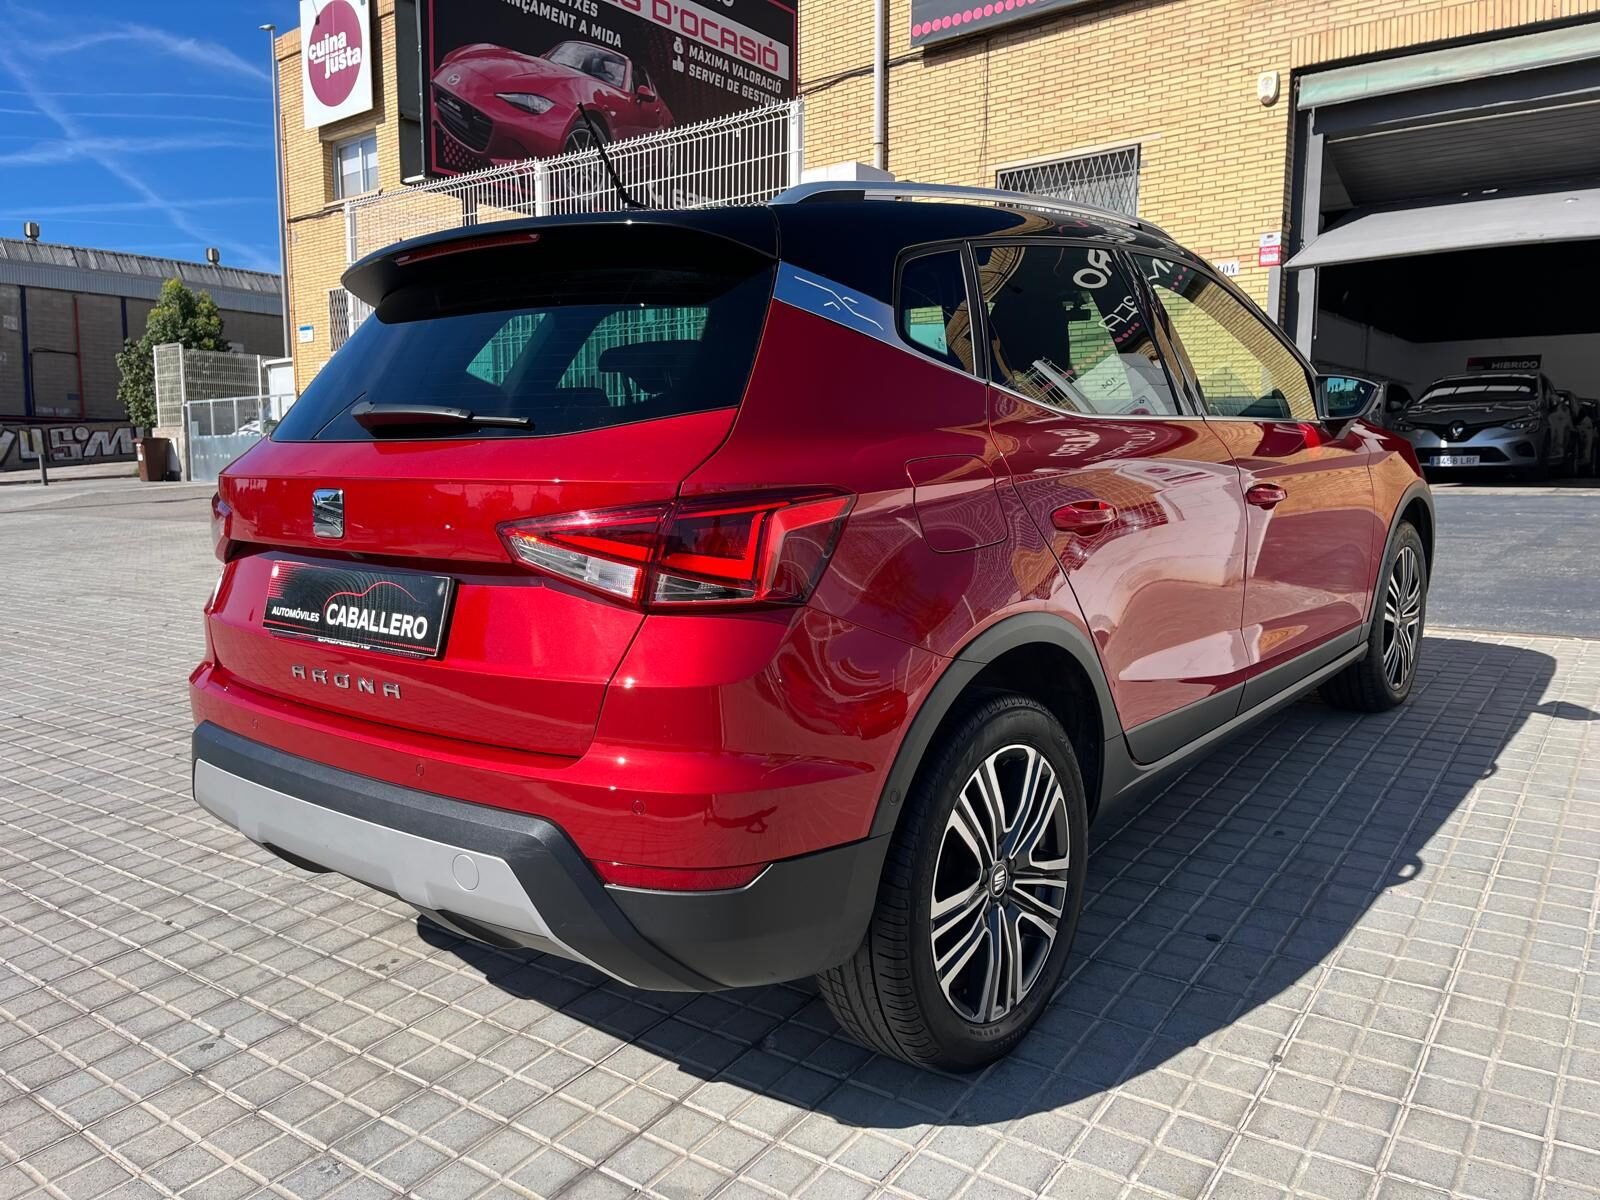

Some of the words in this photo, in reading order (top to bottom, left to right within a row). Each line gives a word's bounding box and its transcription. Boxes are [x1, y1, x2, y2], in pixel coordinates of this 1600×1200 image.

[308, 31, 347, 60] cuina
[578, 19, 588, 35] A
[591, 23, 622, 48] MIDA
[652, 0, 779, 72] D'OCASIÓ
[324, 46, 361, 80] justa
[689, 44, 729, 73] MÀXIMA
[732, 62, 782, 94] VALORACIÓ
[689, 64, 724, 89] SERVEI
[727, 78, 740, 94] DE
[271, 606, 321, 623] AUTOMÓVILES
[325, 603, 428, 640] CABALLERO
[291, 664, 401, 699] ARONA
